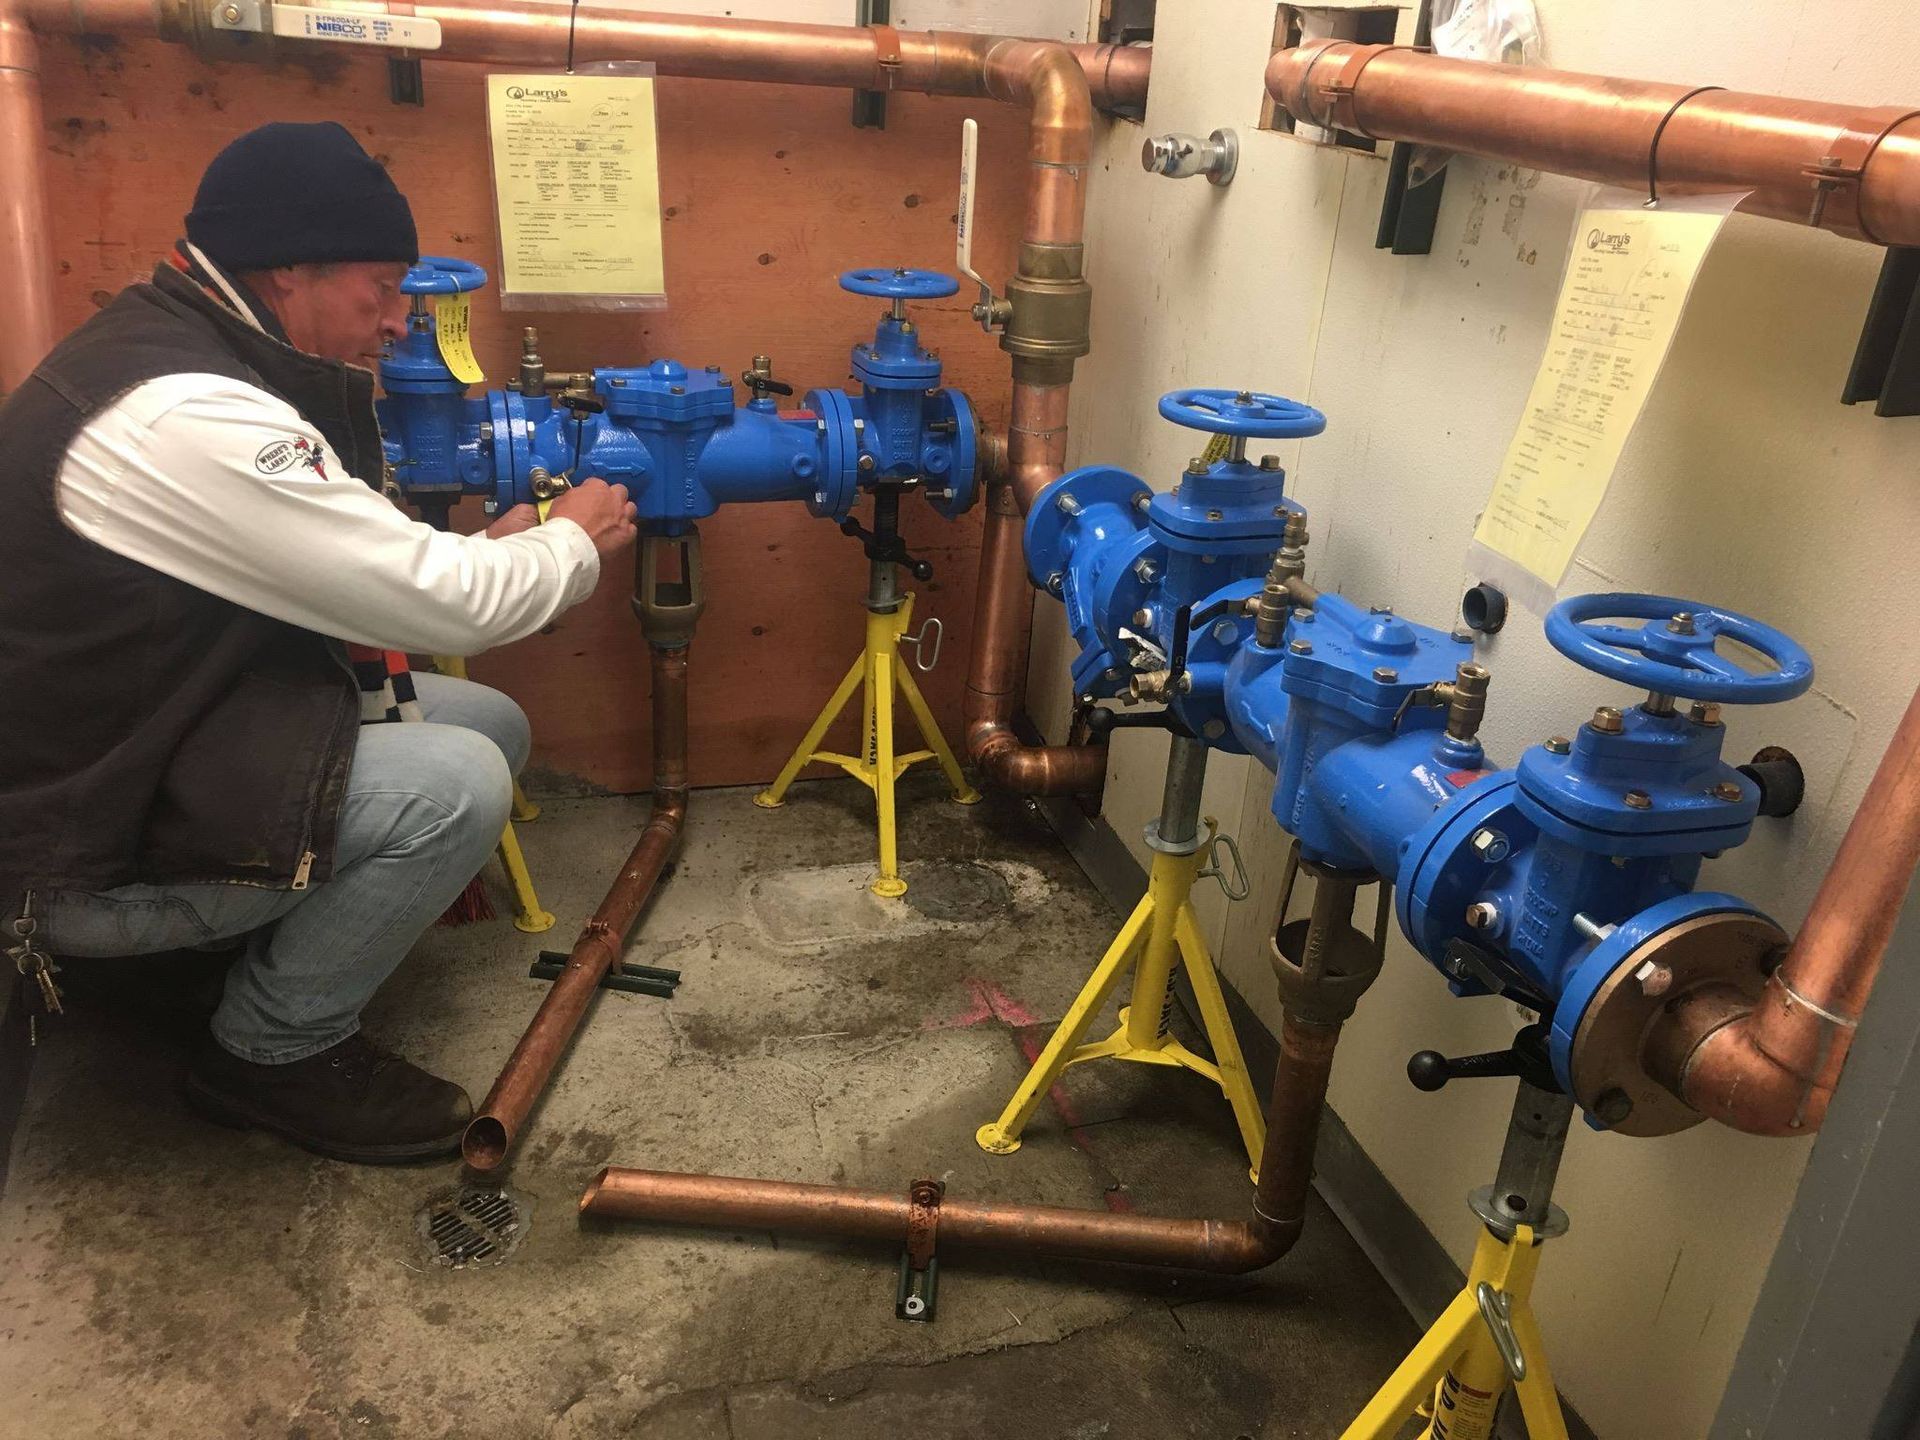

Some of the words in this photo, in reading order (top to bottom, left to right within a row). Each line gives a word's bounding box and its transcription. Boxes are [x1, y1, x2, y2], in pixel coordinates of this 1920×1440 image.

[316, 22, 363, 34] NIBCO
[525, 87, 569, 99] Larry's
[1600, 231, 1632, 248] Larry's
[258, 444, 289, 464] WHERE'S
